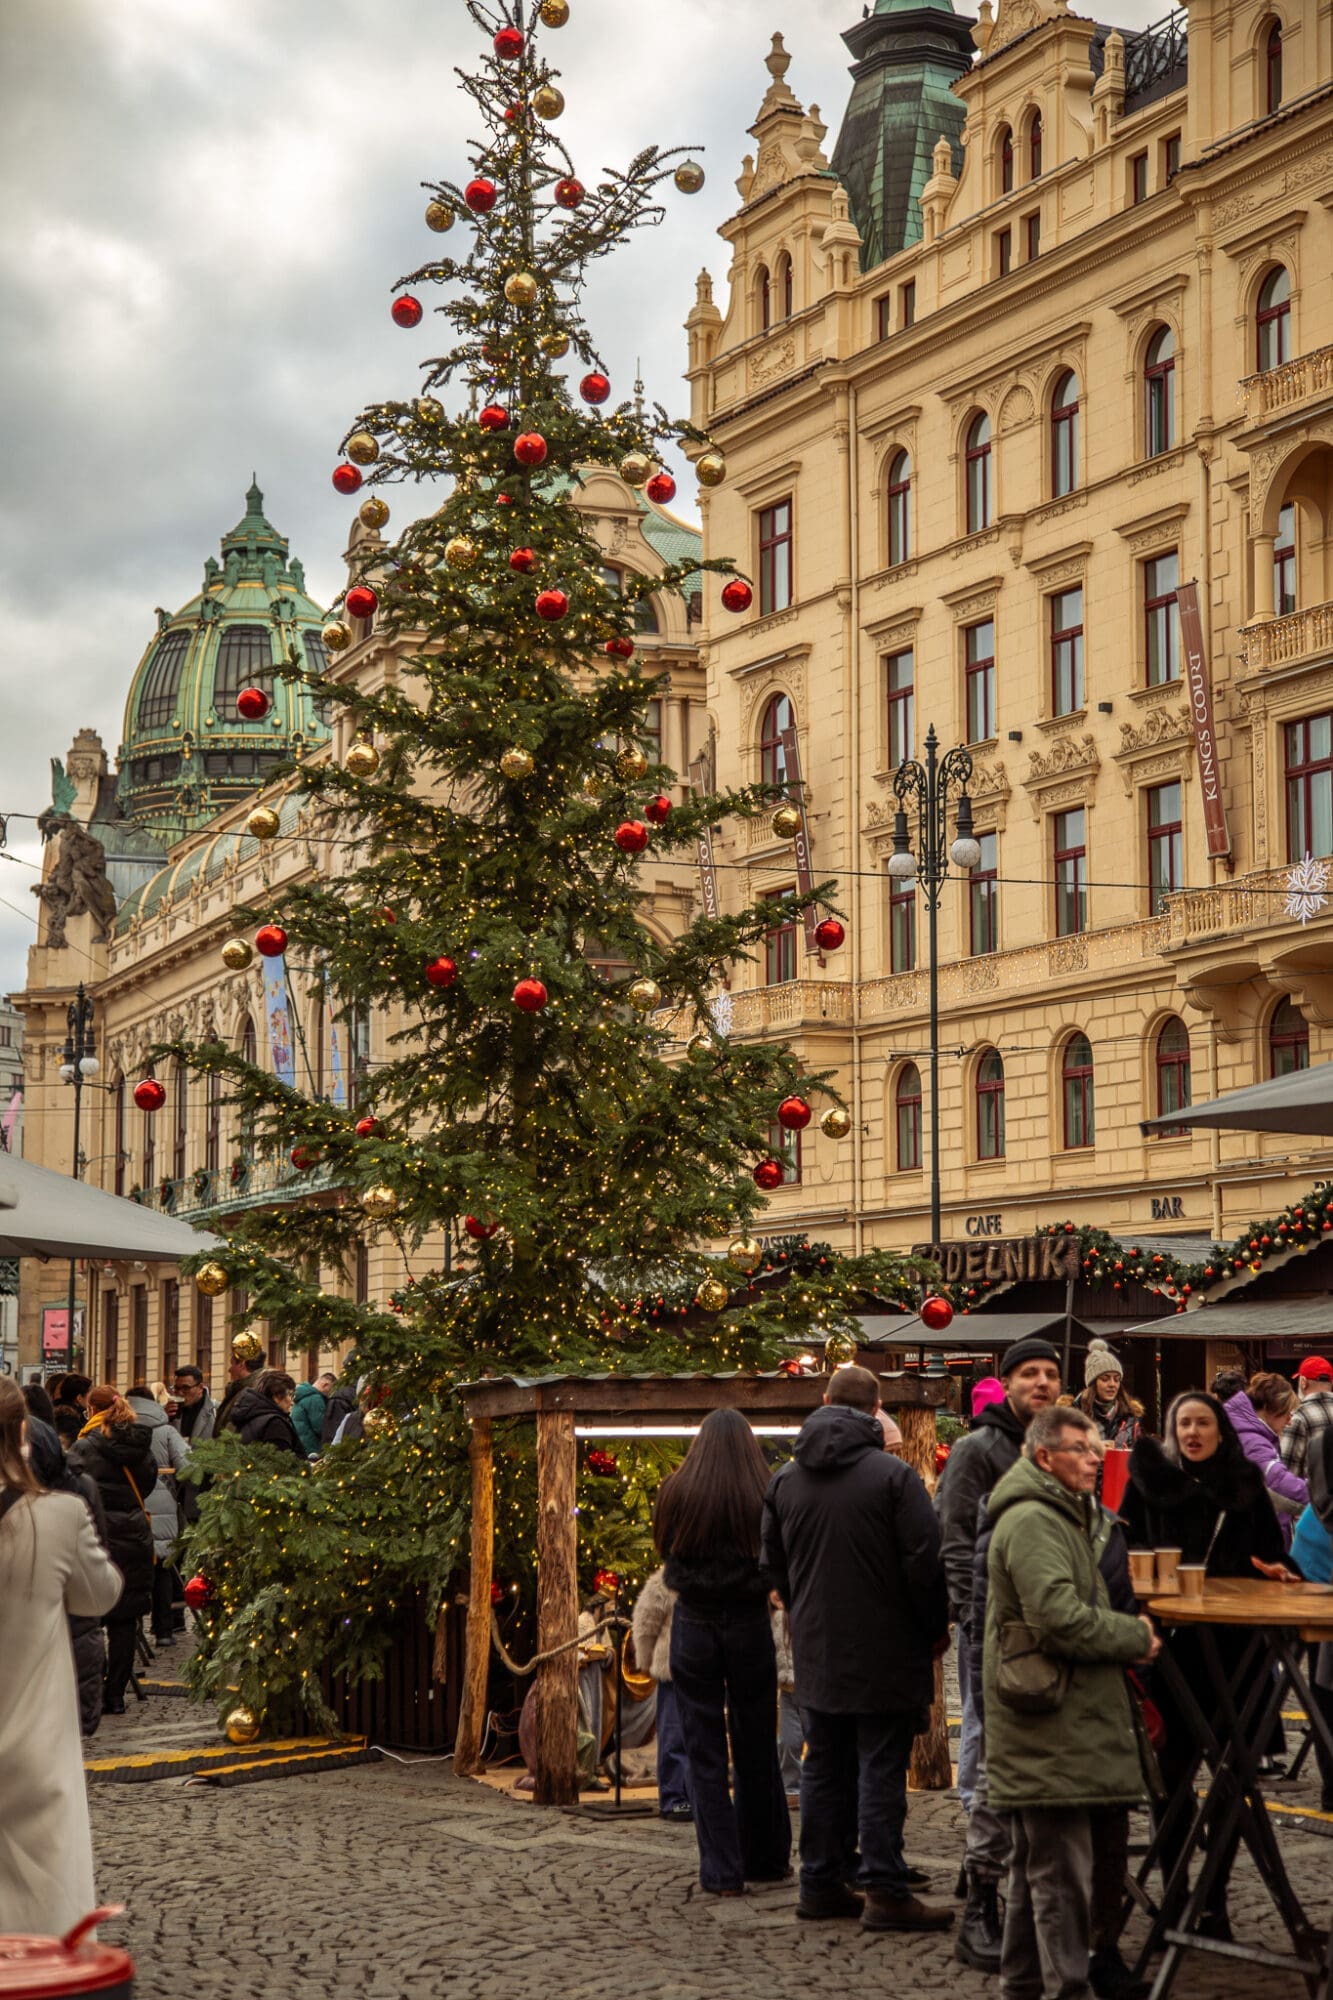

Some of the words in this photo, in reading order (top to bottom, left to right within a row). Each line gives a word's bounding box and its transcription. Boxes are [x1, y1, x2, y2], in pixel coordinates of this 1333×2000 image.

[1189, 650, 1208, 724] COURT
[1199, 729, 1218, 801] KINGS
[965, 1214, 1003, 1236] CAFE
[1151, 1196, 1186, 1220] BAR
